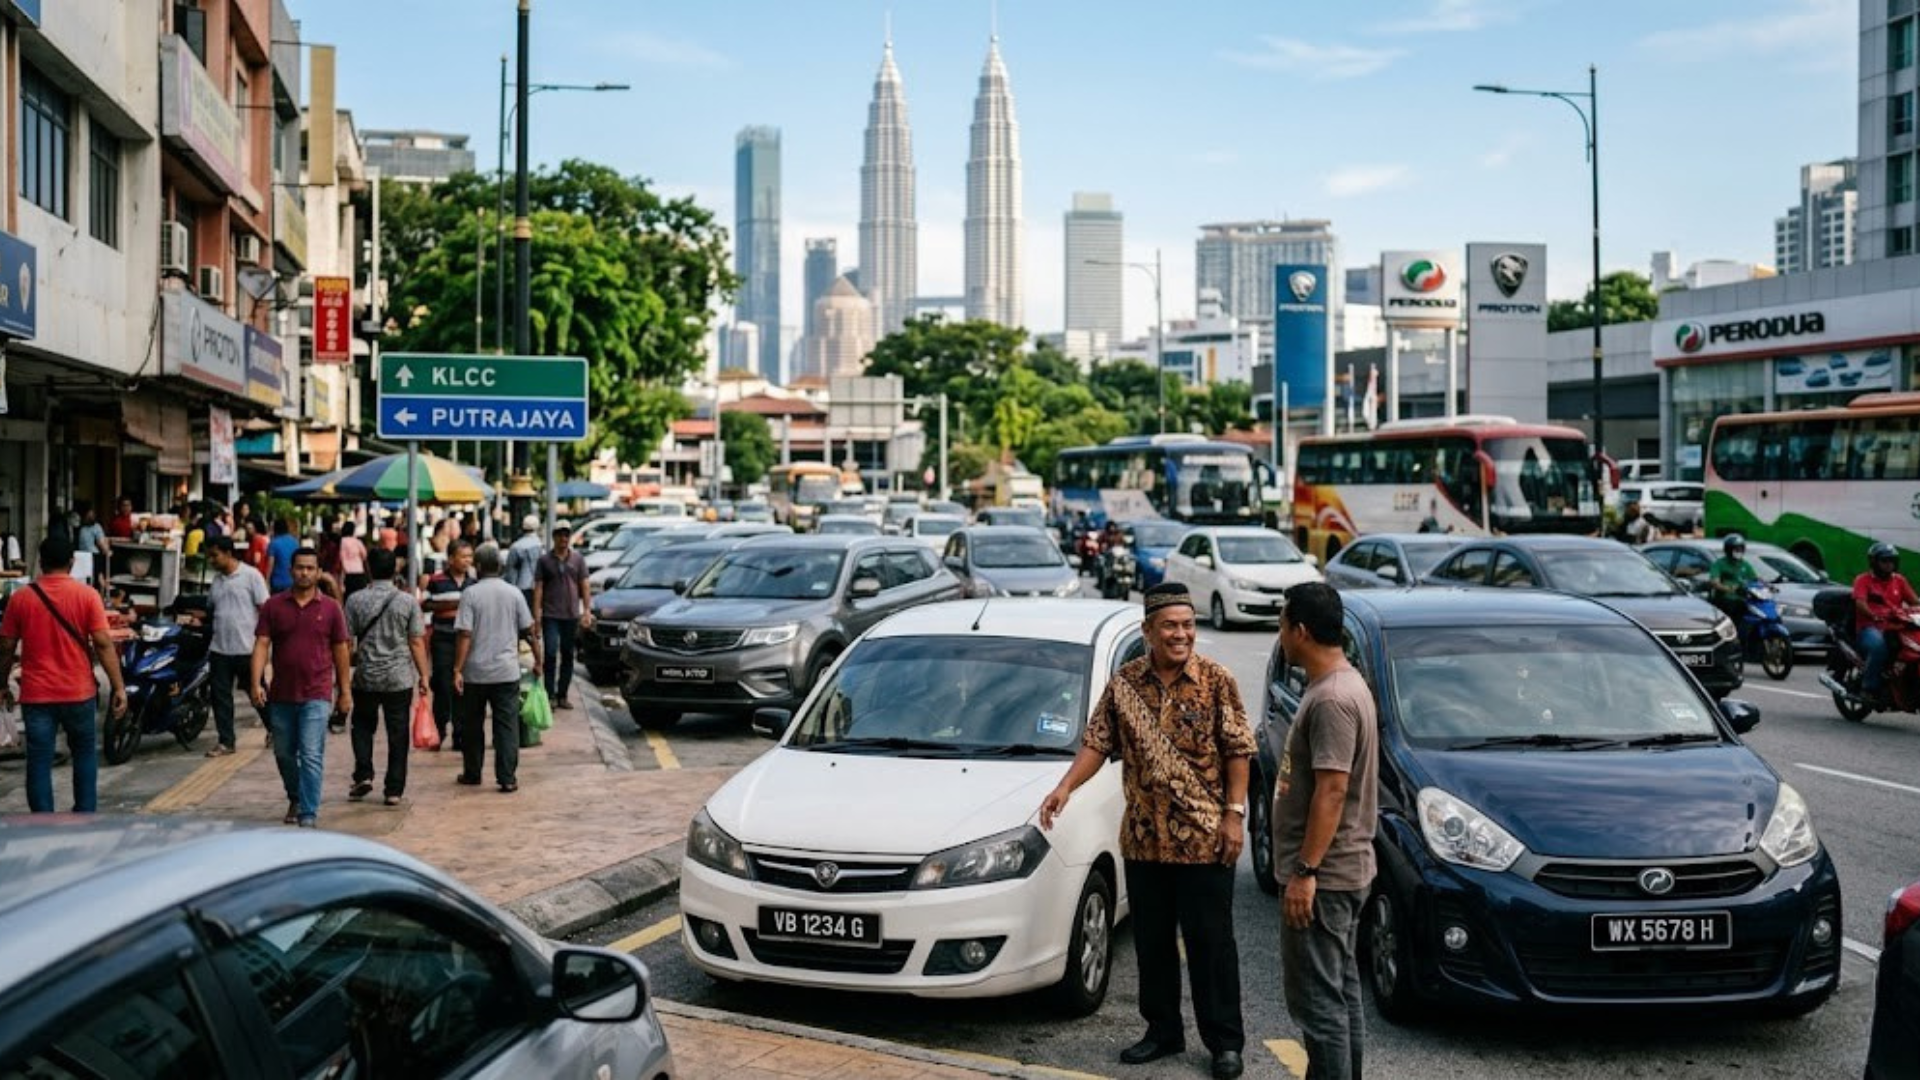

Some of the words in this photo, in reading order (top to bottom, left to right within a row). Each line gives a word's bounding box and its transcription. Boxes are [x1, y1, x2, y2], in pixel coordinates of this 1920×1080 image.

[1478, 303, 1541, 313] PROTON
[432, 367, 496, 387] KLCC
[432, 407, 575, 429] PUTRAJAYA
[774, 911, 797, 932] VB
[801, 913, 847, 937] 1234
[851, 916, 864, 938] G
[1608, 919, 1636, 941] WX
[1641, 919, 1695, 941] 5678
[1701, 919, 1714, 940] H
